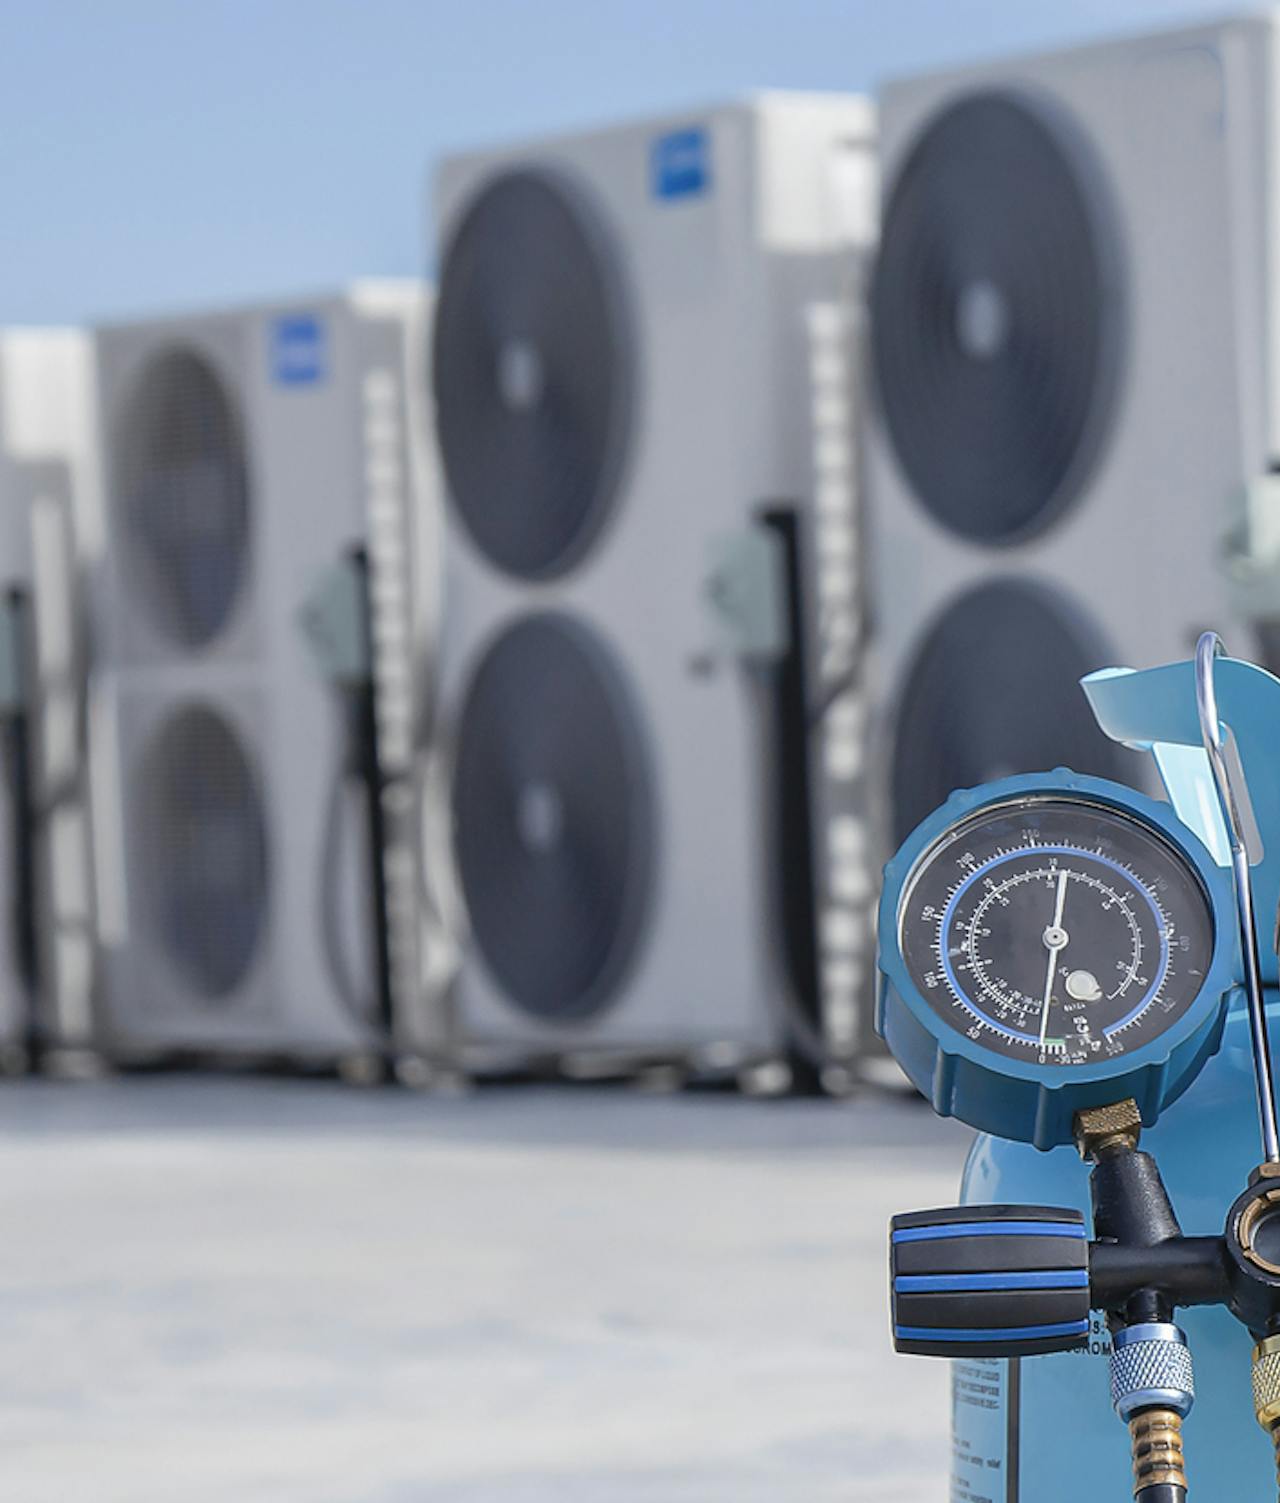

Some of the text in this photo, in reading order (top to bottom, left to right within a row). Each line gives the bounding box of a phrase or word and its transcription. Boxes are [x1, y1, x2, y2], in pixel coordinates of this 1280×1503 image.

[956, 852, 975, 868] 200
[921, 905, 935, 920] 150
[923, 971, 938, 988] 100
[966, 1026, 980, 1039] 50
[1039, 1055, 1047, 1064] 0
